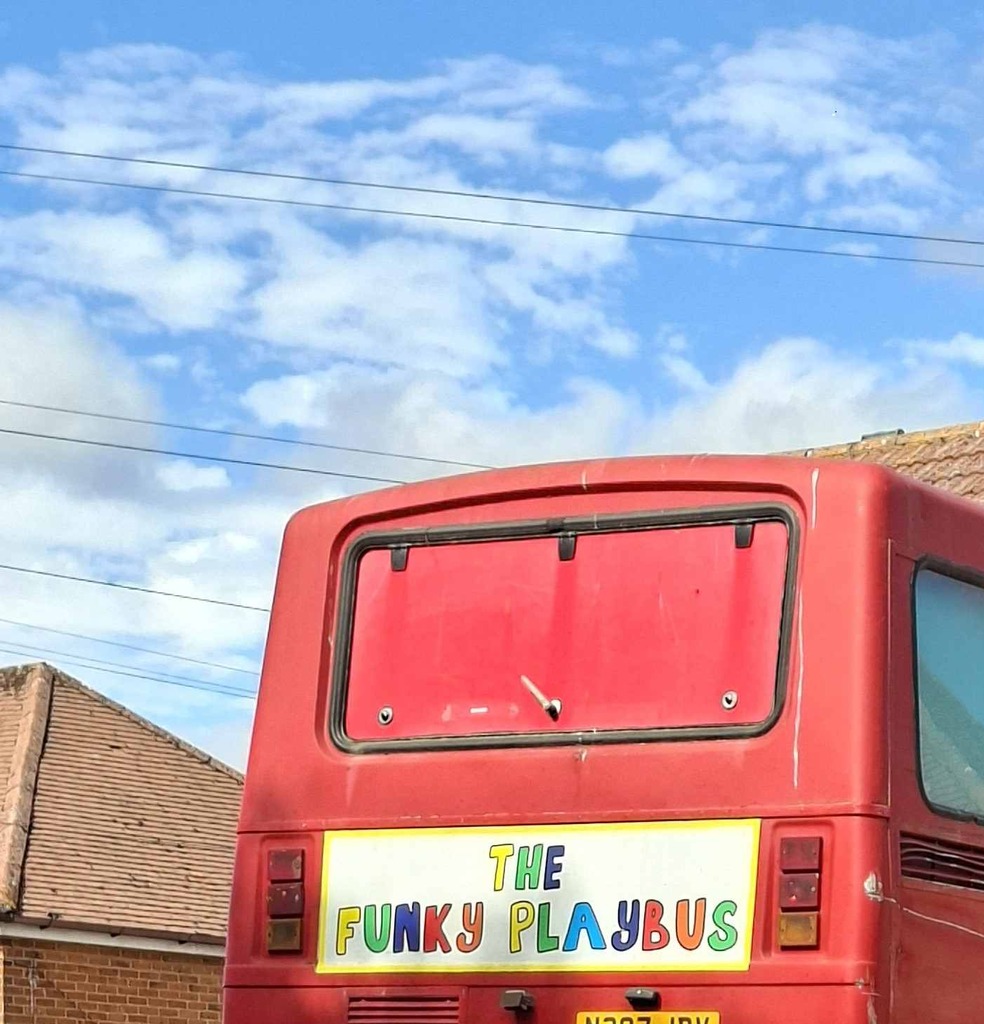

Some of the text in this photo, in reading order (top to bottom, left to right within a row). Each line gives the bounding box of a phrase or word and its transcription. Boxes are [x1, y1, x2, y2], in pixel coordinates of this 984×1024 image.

[489, 843, 565, 891] THE
[335, 898, 738, 955] FUNKY PLAYBUS
